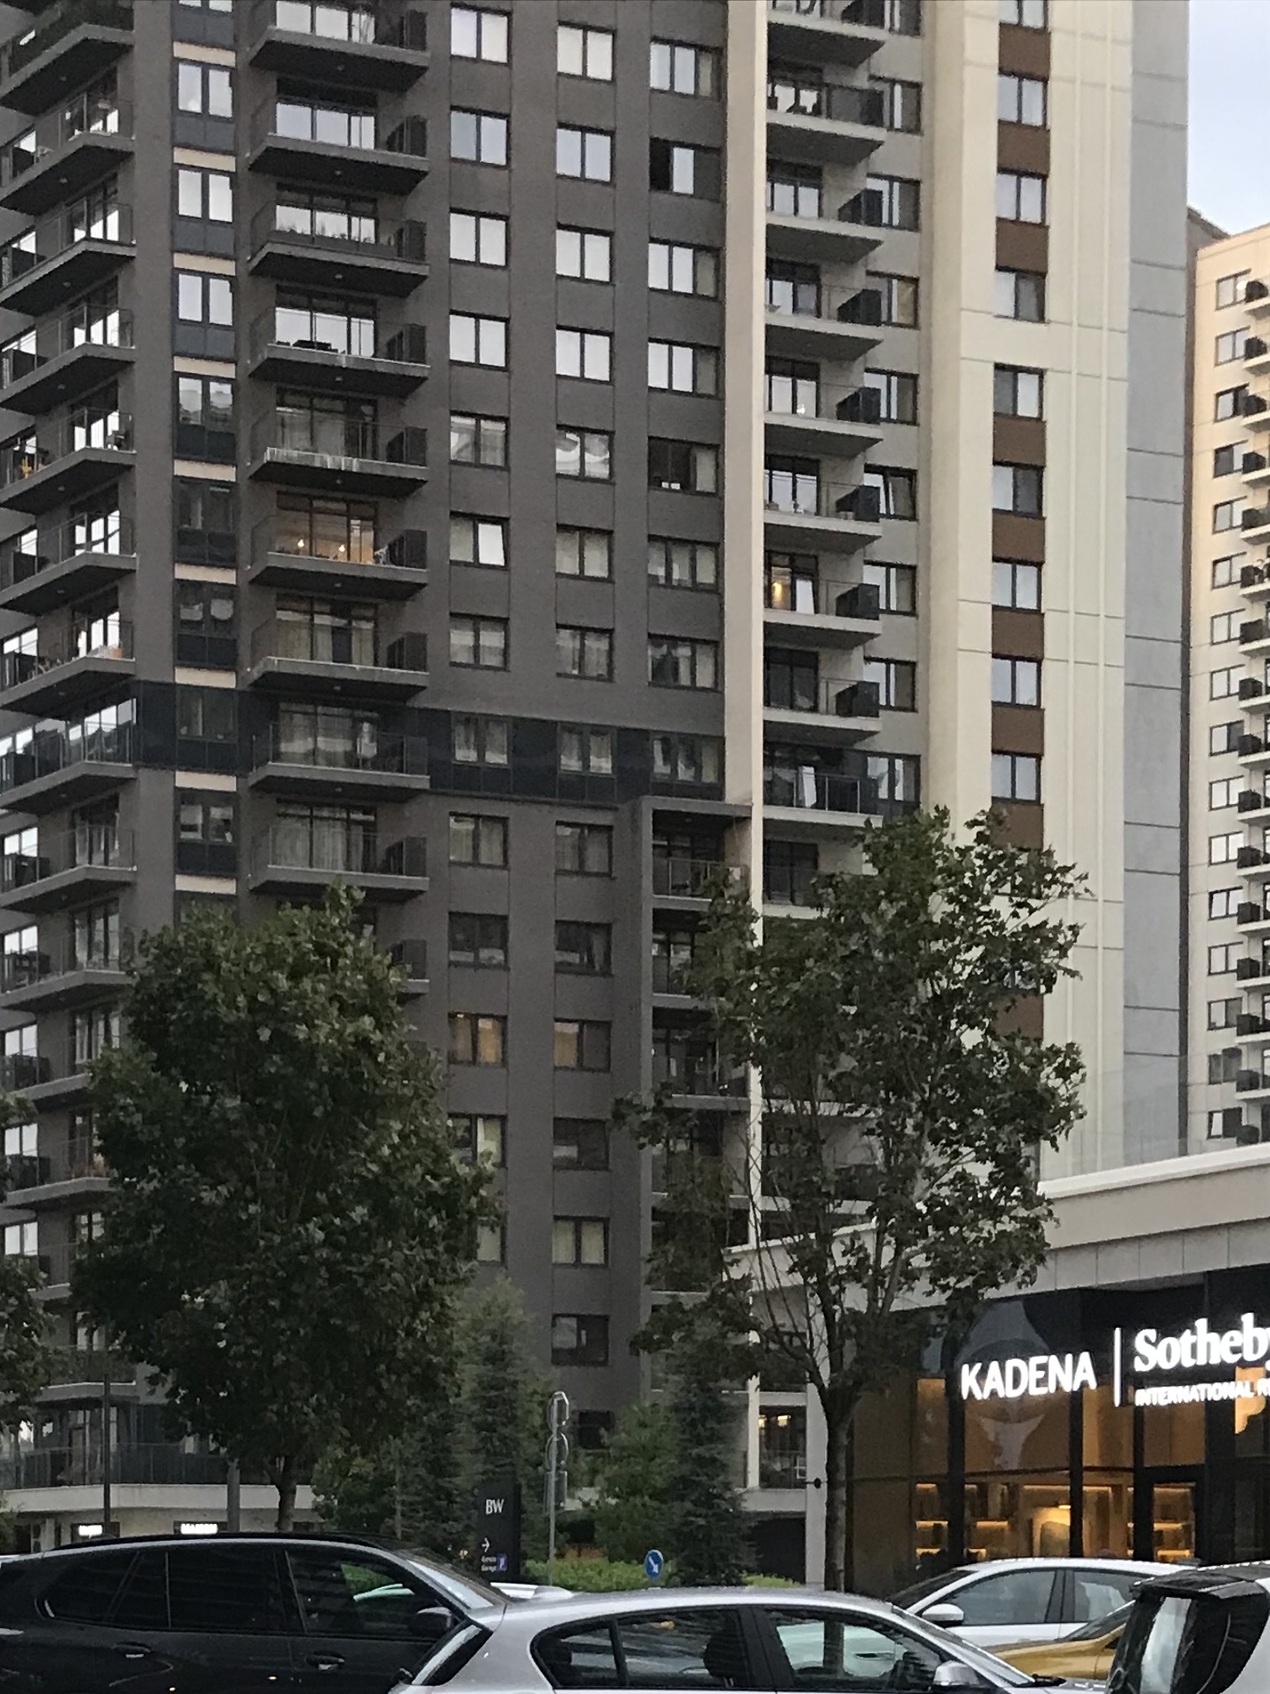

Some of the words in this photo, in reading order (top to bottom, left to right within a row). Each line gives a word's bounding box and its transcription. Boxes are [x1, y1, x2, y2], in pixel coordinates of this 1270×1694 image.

[961, 1351, 1098, 1401] KADENA
[1135, 1381, 1255, 1407] INTERNATIONAL
[485, 1499, 504, 1515] BW
